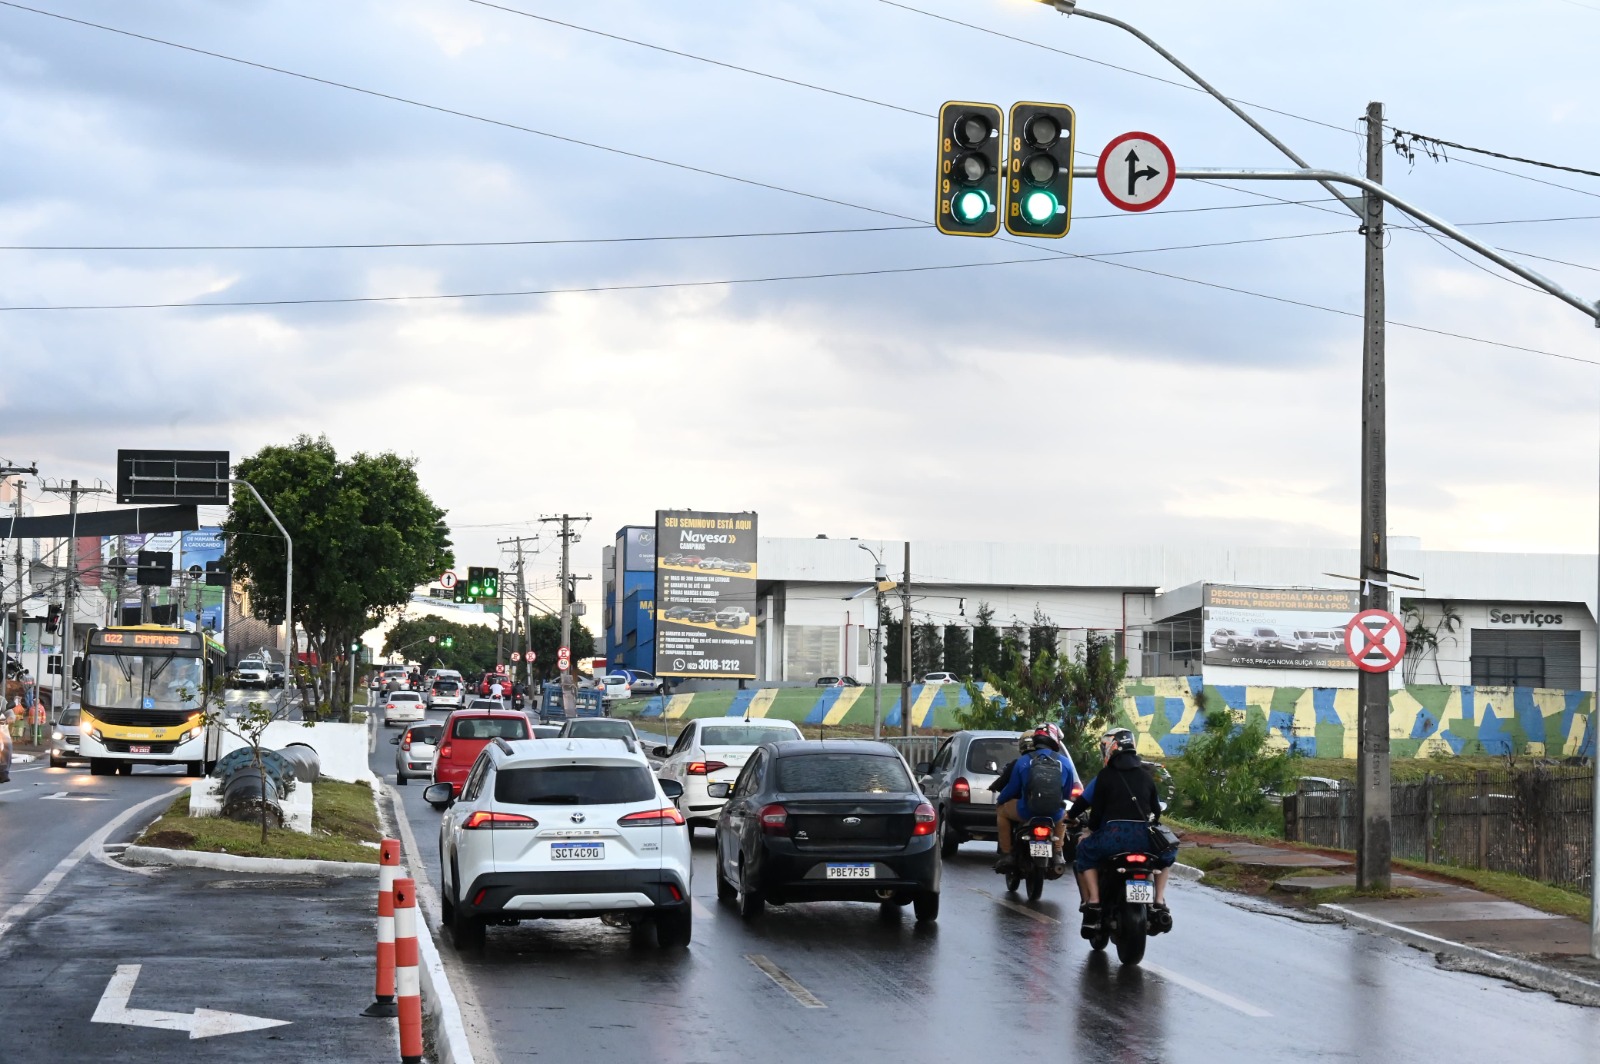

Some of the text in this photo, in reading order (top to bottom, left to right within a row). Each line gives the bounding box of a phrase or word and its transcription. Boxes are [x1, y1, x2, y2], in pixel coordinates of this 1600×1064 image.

[664, 517, 752, 530] SEU SEMINOVO ESTÁ AQUI
[680, 530, 727, 544] Navesa
[484, 578, 496, 587] 07
[1211, 589, 1258, 599] DESCONTO
[1260, 592, 1300, 600] ESPECIAL
[1327, 594, 1350, 603] CNPJ,
[1211, 598, 1252, 608] FROTISTA,
[1490, 608, 1563, 627] Serviços
[104, 634, 179, 645] 022 CAMPINAS
[698, 659, 739, 671] 3018-1212
[830, 868, 870, 877] PBE7F35
